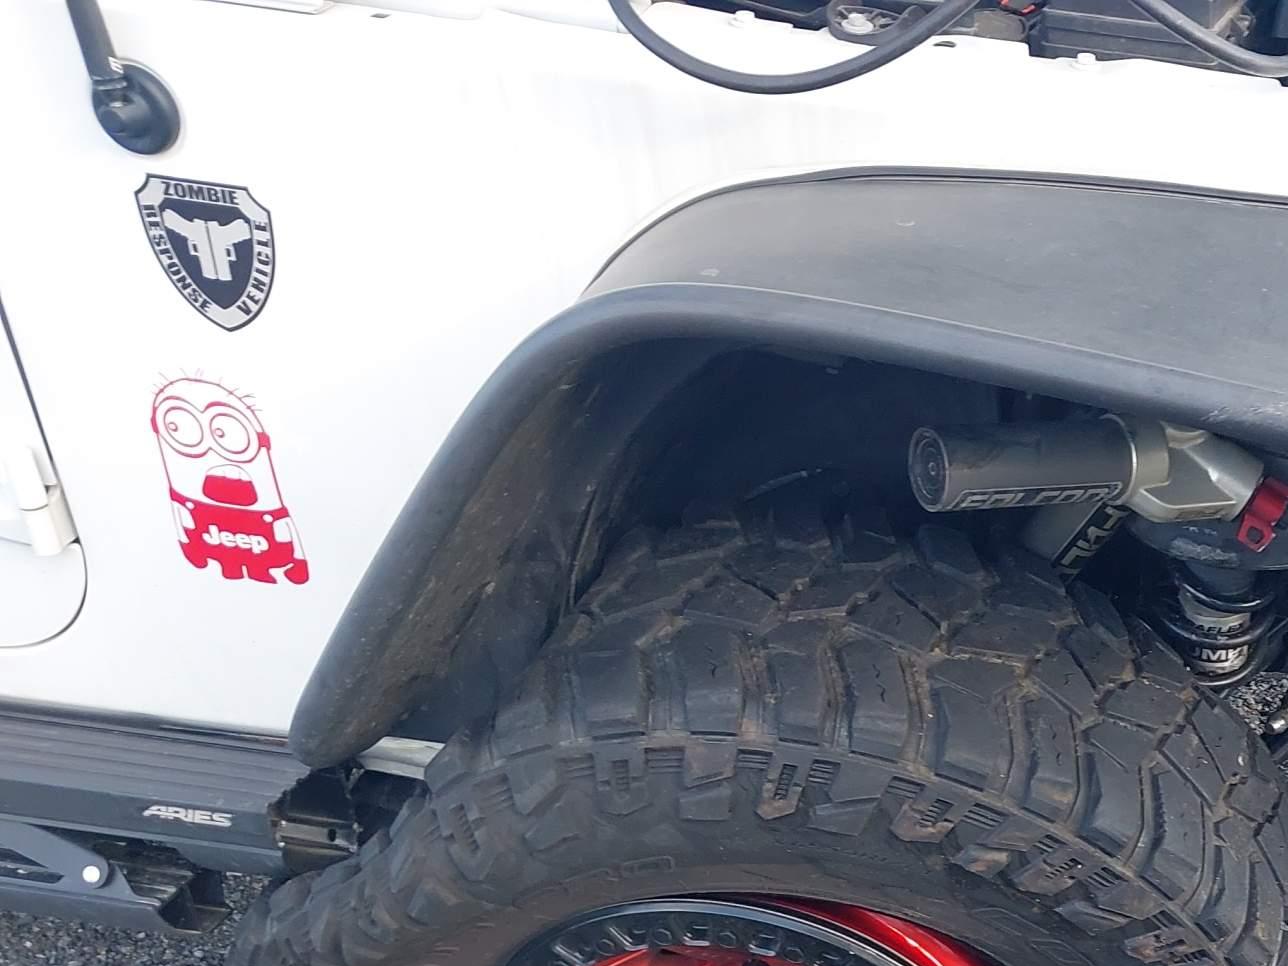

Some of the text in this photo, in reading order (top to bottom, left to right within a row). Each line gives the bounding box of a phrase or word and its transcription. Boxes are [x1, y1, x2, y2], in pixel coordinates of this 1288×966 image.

[161, 180, 240, 206] ZOMBIE
[141, 203, 213, 313] RESPONSE
[236, 219, 271, 316] VEHICLE
[202, 524, 269, 554] Jeep
[142, 805, 233, 827] ARIES
